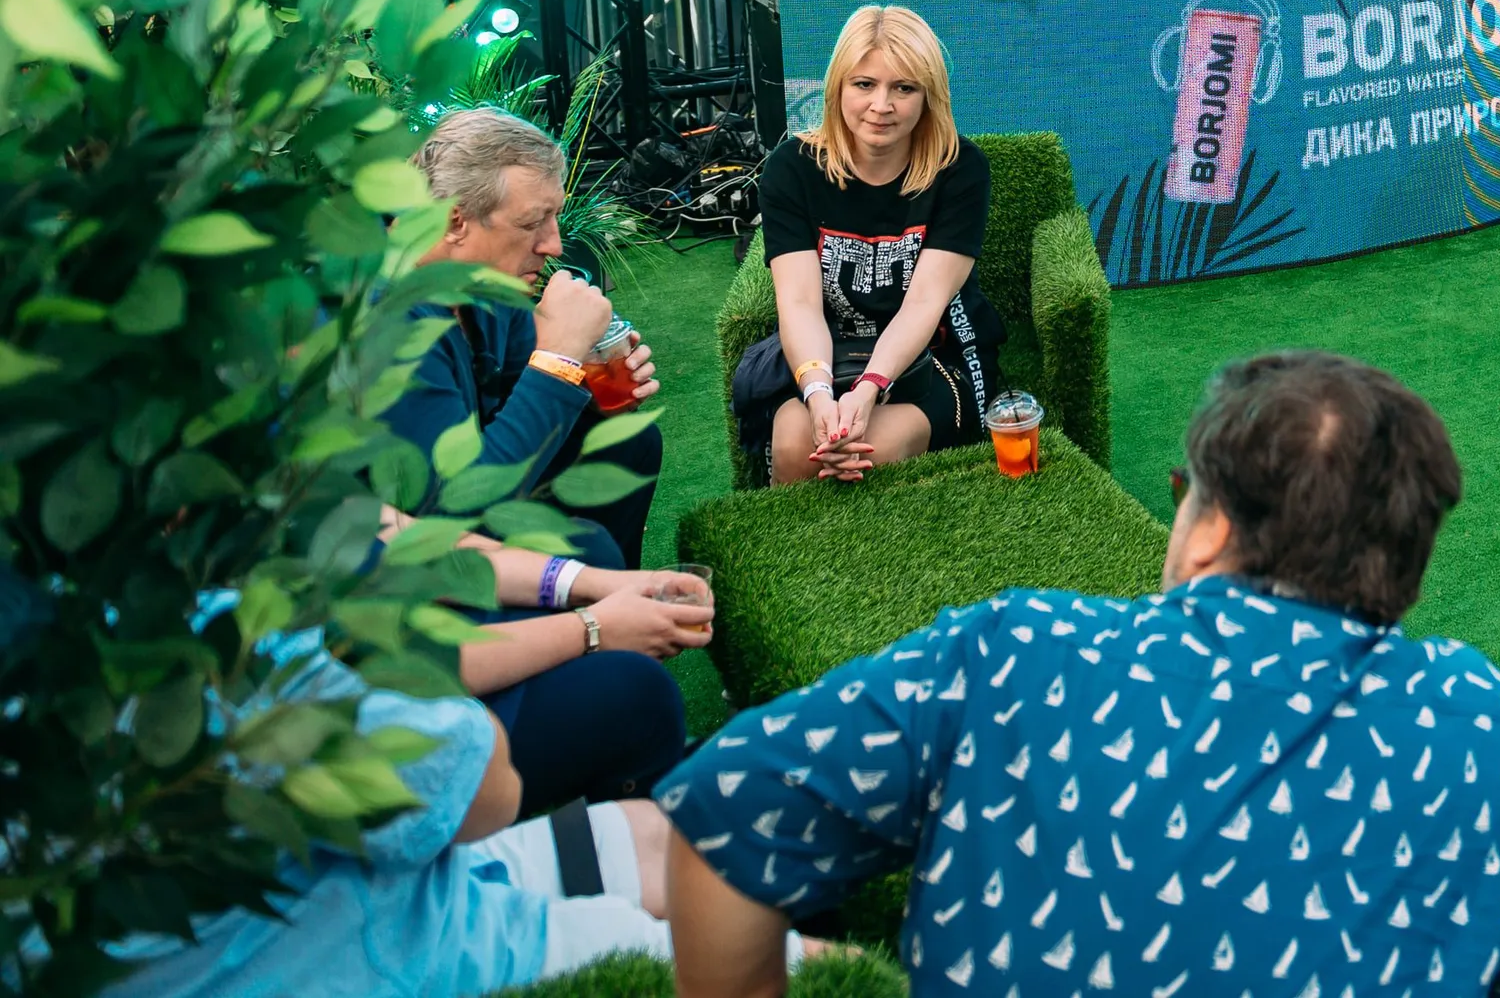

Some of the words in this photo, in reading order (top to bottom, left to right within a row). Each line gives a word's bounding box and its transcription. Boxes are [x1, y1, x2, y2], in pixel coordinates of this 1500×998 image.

[1189, 32, 1238, 185] BORJOMI
[1303, 78, 1401, 109] FLAVORED
[1406, 68, 1466, 93] WATER
